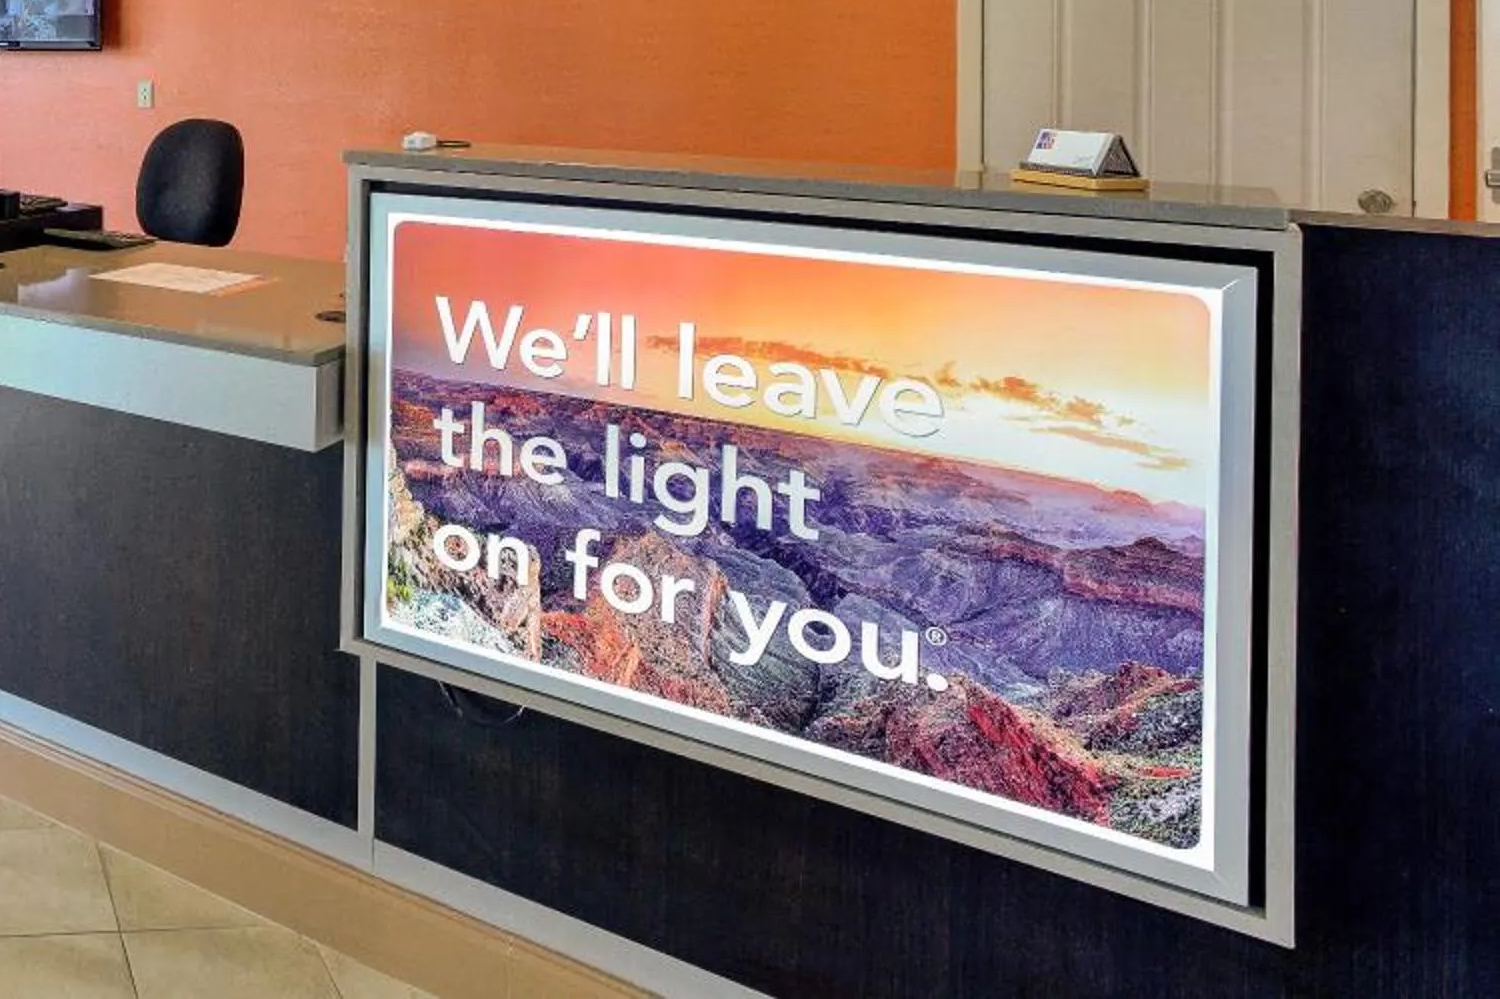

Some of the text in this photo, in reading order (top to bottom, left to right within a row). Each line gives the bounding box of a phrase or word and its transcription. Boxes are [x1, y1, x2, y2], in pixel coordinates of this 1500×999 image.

[435, 295, 948, 438] We'll leave
[432, 401, 822, 540] the light
[432, 523, 530, 587] on
[564, 527, 696, 624] for
